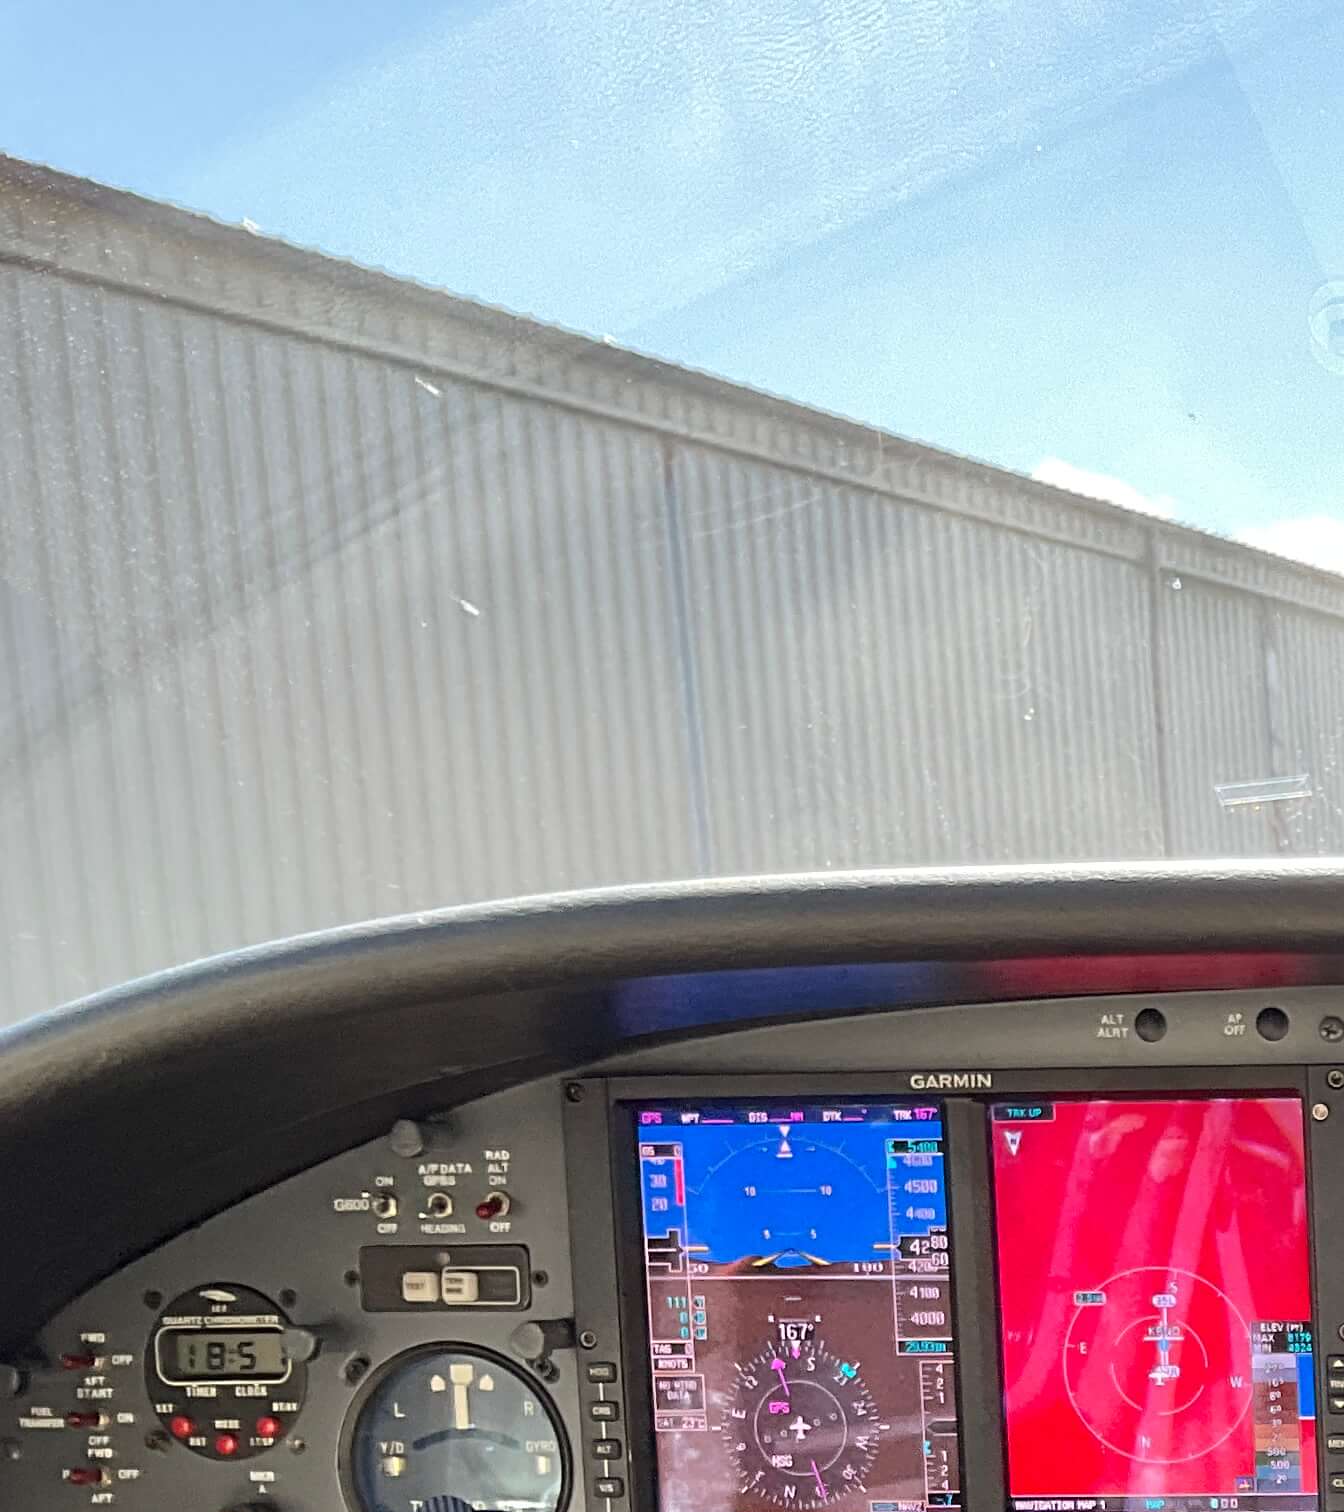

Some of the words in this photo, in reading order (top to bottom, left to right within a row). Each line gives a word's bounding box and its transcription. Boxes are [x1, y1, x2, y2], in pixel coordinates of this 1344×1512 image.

[910, 1074, 992, 1089] GARMIN
[911, 1312, 944, 1325] 4000
[779, 1323, 814, 1341] 167°
